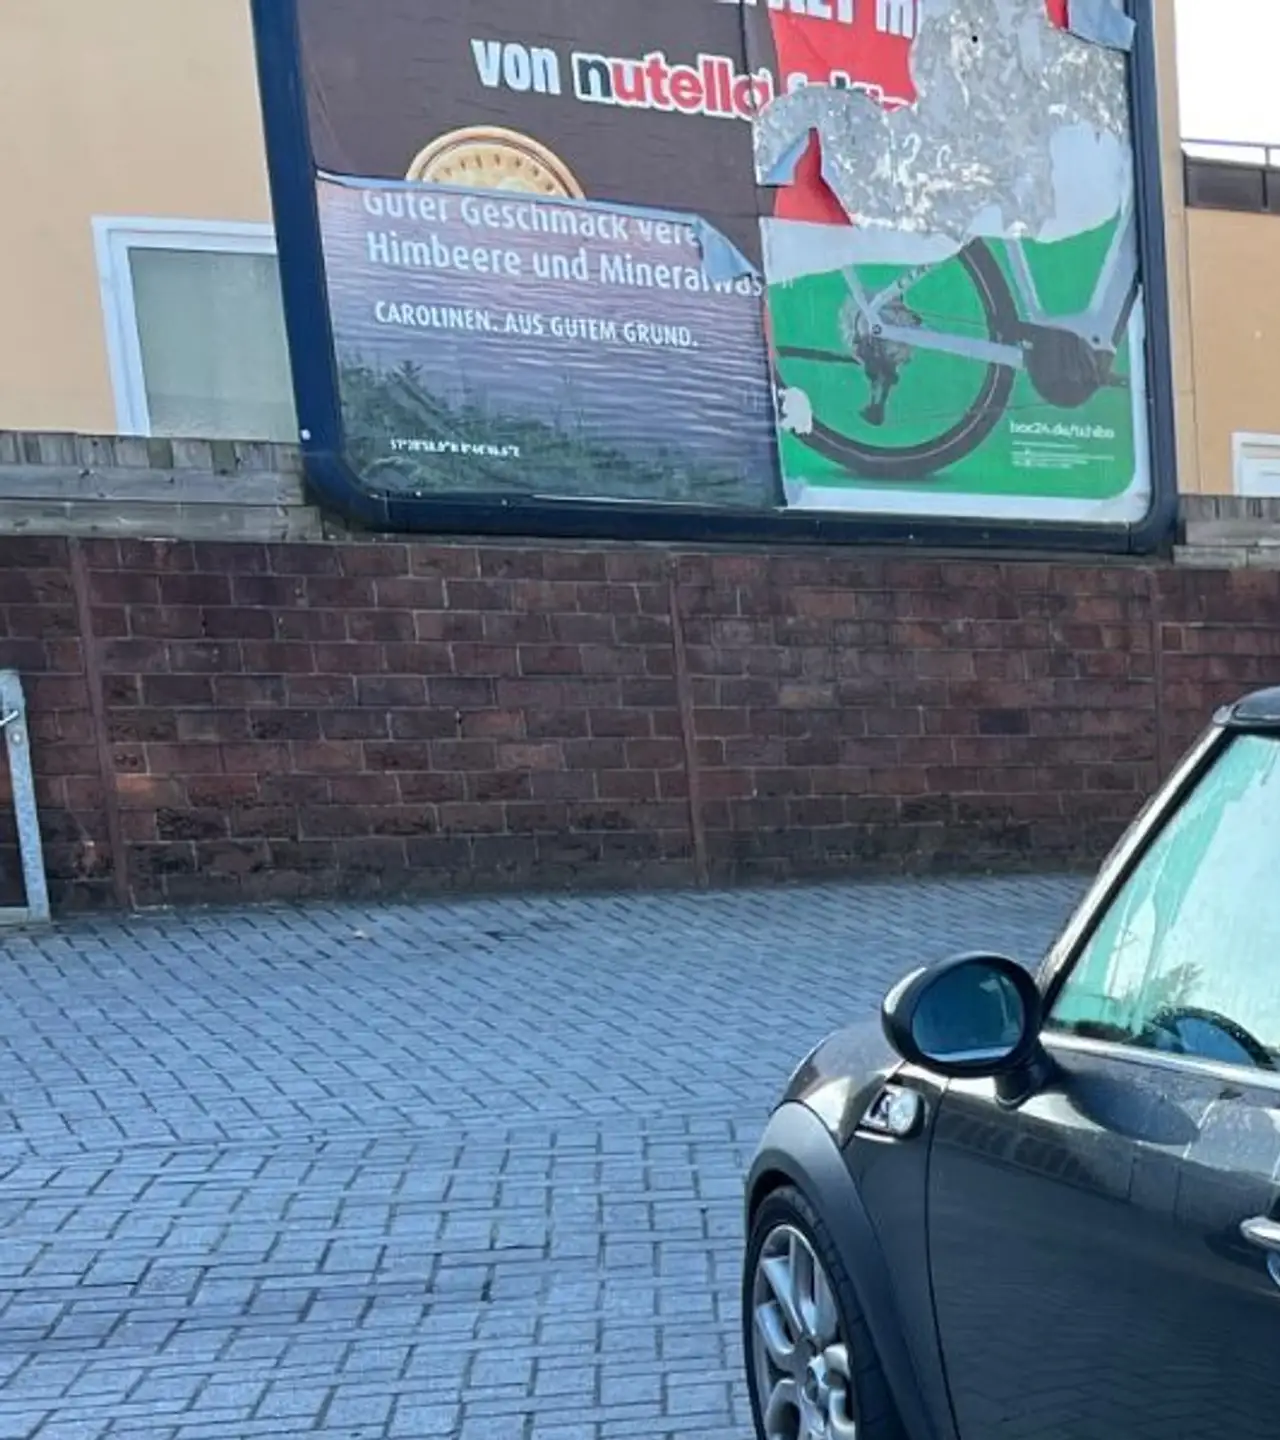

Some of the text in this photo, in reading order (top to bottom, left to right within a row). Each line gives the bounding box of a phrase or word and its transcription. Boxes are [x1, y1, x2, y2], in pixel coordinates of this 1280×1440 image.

[470, 38, 561, 95] von
[572, 51, 775, 121] nutella
[363, 189, 448, 223] Guter
[461, 195, 628, 241] Geschmack
[367, 231, 521, 275] Himbeere
[534, 247, 589, 281] und
[375, 301, 699, 347] CAROLINEN. AUS GUTEM GRUND.
